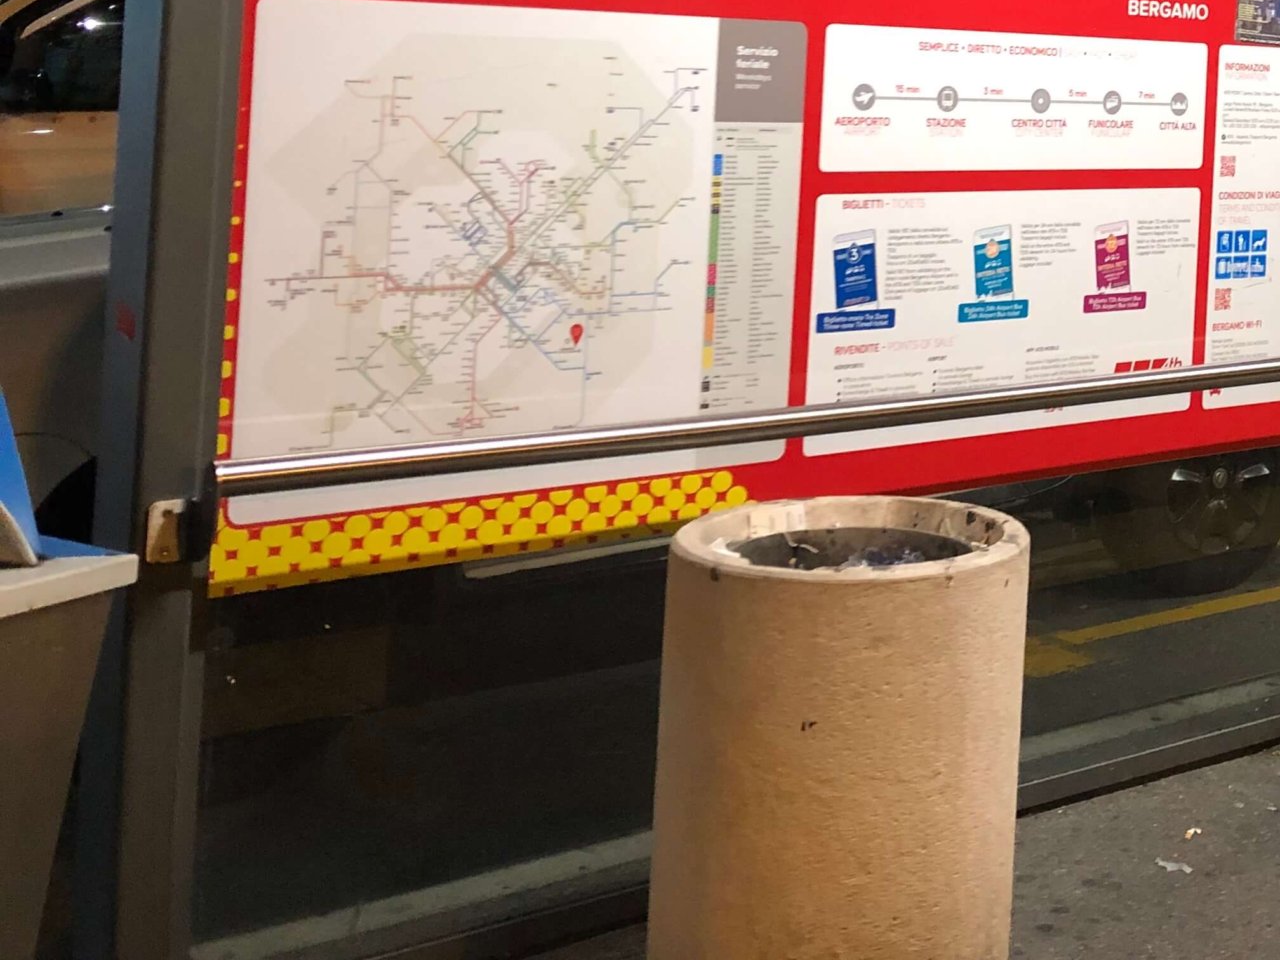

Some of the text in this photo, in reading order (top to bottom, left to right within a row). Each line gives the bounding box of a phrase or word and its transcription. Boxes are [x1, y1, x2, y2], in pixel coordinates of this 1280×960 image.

[1128, 0, 1209, 21] BERGAMO
[834, 117, 890, 126] AEROPORTO
[926, 118, 966, 127] STAZIONE
[842, 199, 884, 210] BIGLIETTI
[851, 248, 858, 260] 3
[834, 343, 880, 356] RIVENDITE
